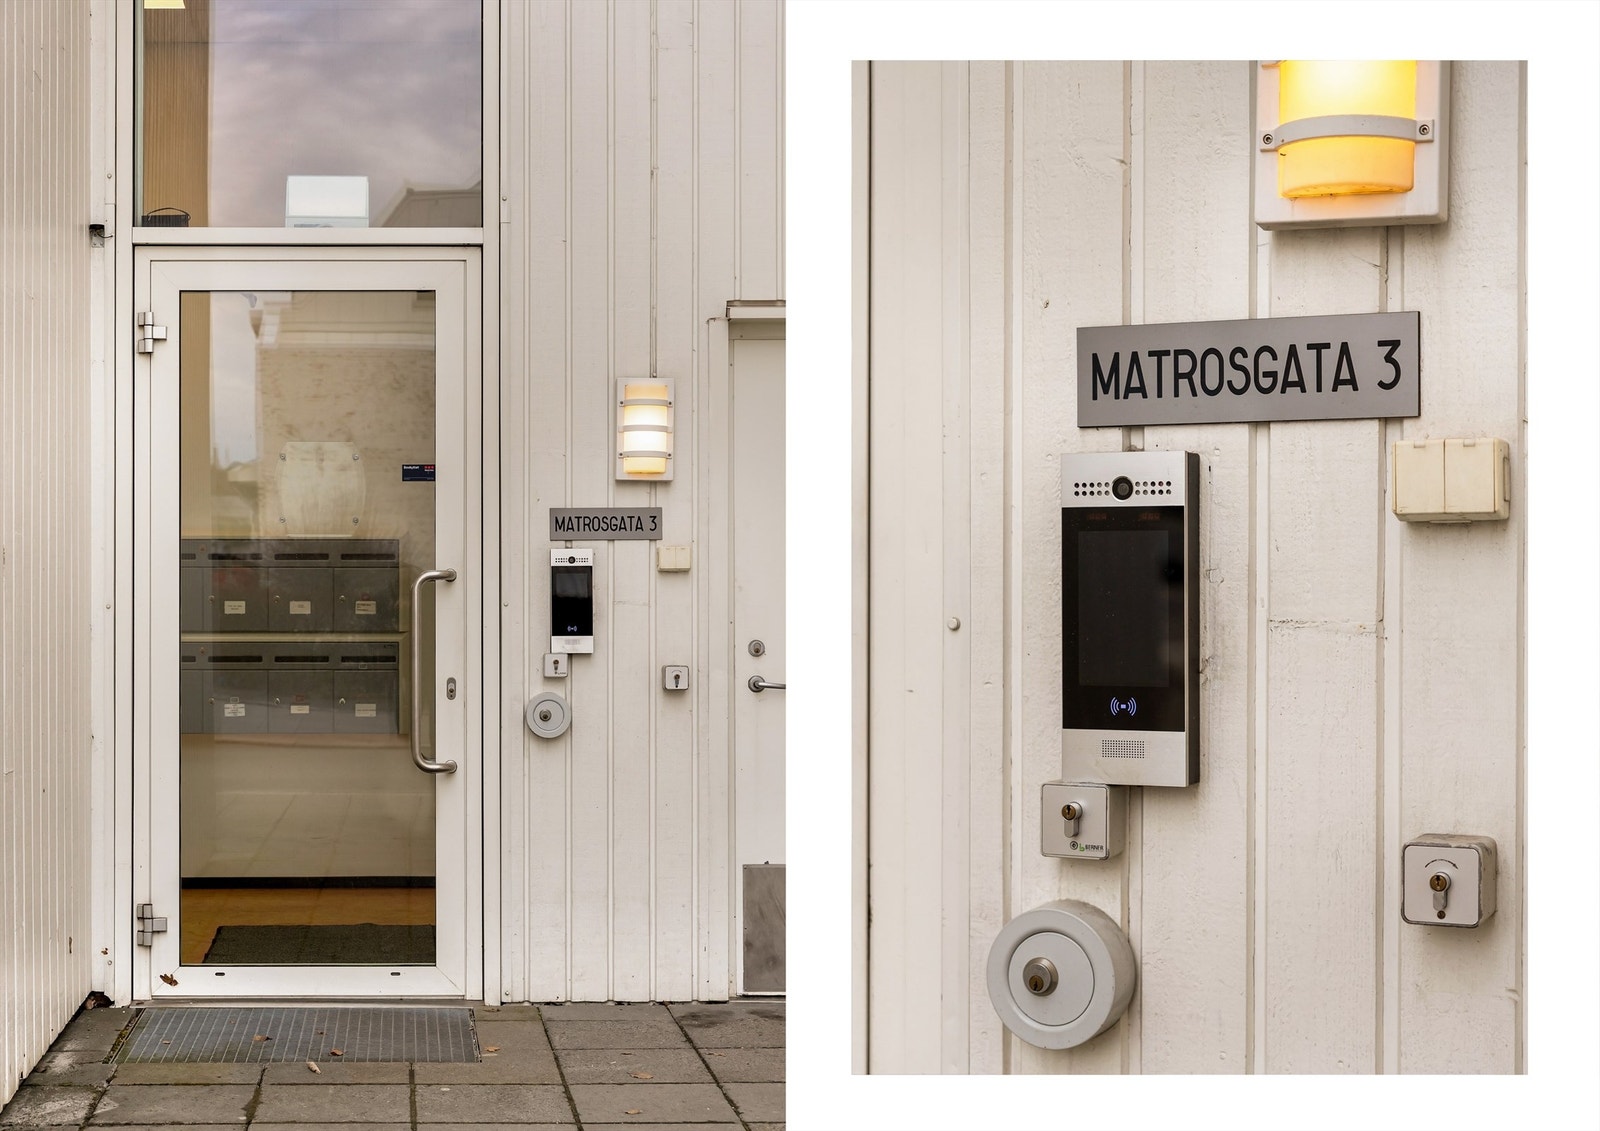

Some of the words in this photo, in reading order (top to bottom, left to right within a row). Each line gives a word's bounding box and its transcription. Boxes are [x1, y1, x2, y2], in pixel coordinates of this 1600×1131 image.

[1092, 342, 1359, 400] MATROSGATA
[1377, 339, 1401, 391] 3
[555, 516, 644, 532] MATROSGATA
[649, 515, 657, 531] 3
